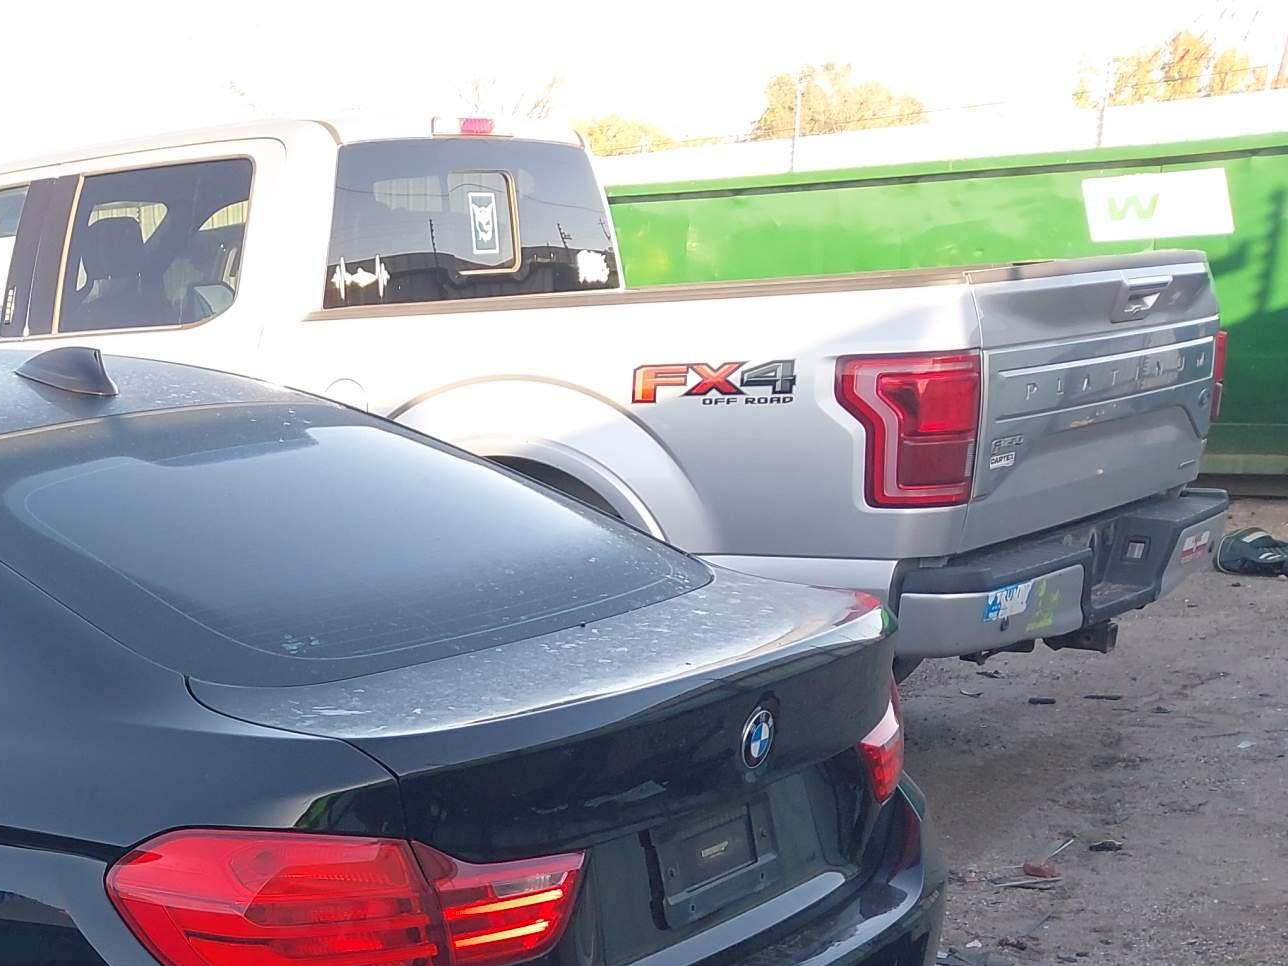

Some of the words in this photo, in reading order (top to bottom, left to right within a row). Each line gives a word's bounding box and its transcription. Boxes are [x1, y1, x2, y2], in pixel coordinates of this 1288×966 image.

[631, 359, 797, 404] FX4
[702, 396, 737, 406] OFF
[744, 395, 794, 406] ROAD
